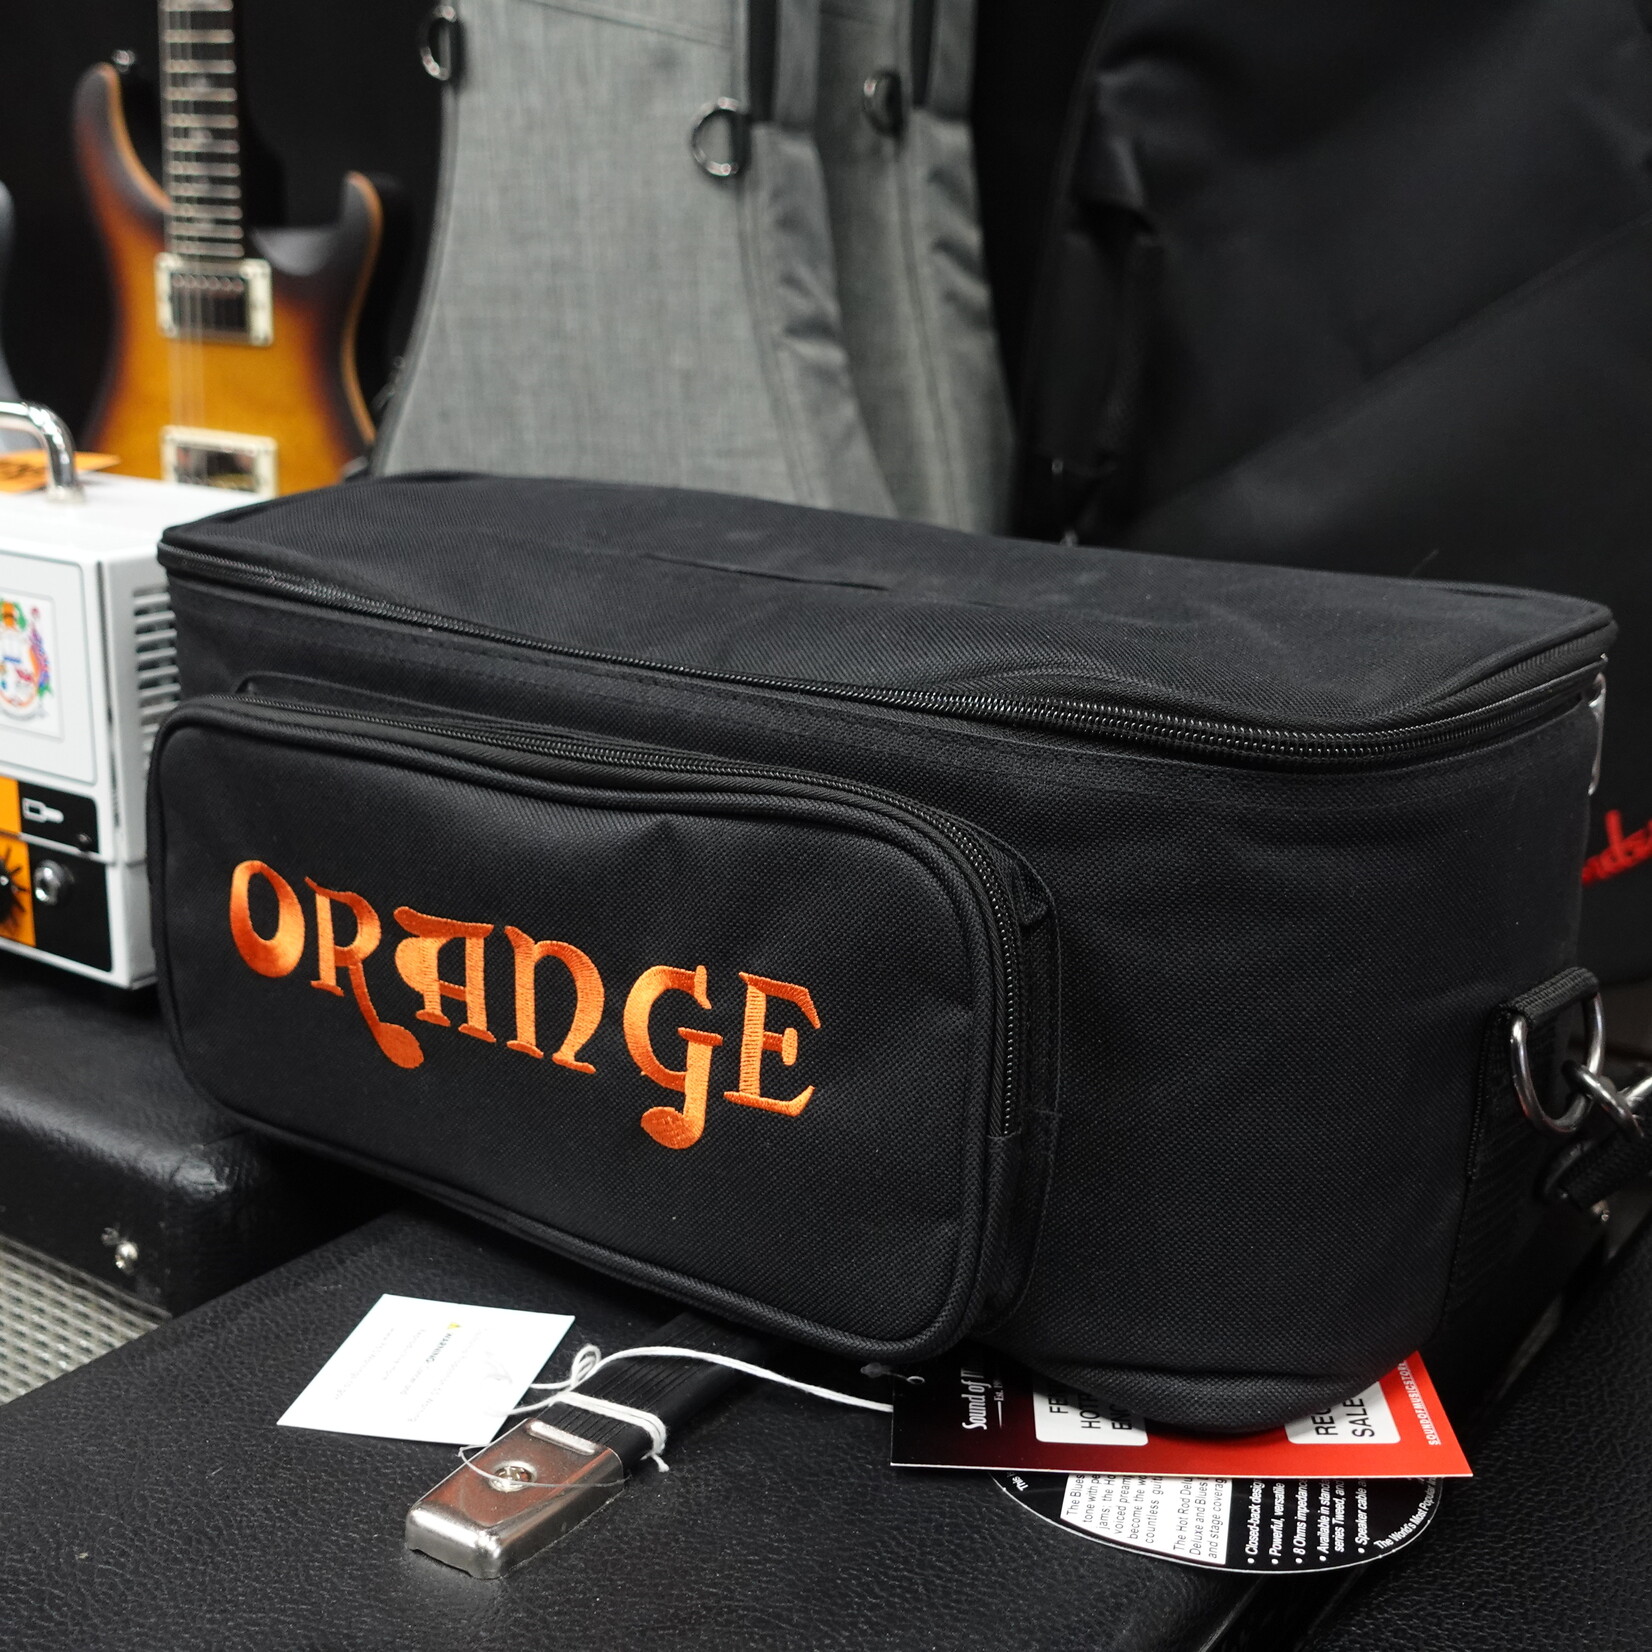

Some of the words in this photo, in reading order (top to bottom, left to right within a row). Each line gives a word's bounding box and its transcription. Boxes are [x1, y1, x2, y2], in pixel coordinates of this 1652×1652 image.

[229, 859, 821, 1149] ORANGE
[961, 1379, 992, 1393] of
[961, 1394, 987, 1430] Sound
[1070, 1475, 1085, 1497] Blues
[1086, 1486, 1099, 1502] with
[1102, 1488, 1113, 1502] the
[1133, 1489, 1145, 1502] the
[1194, 1482, 1208, 1505] Blues
[1066, 1499, 1080, 1515] The
[1177, 1497, 1191, 1514] Rod
[1270, 1482, 1285, 1515] versatile
[1333, 1497, 1346, 1524] Tweed,
[1355, 1488, 1367, 1509] cable
[1082, 1504, 1096, 1523] tone
[1114, 1506, 1127, 1534] voiced
[1128, 1506, 1142, 1539] become
[1144, 1499, 1160, 1544] countless
[1175, 1516, 1188, 1532] Hot
[1192, 1507, 1205, 1523] and
[1209, 1514, 1223, 1539] stage
[1244, 1503, 1262, 1555] Closed-back
[1269, 1518, 1285, 1556] Powerful,
[1295, 1522, 1307, 1547] Ohms
[1317, 1516, 1331, 1554] Available
[1355, 1511, 1370, 1545] Speaker
[1173, 1534, 1187, 1551] The
[1189, 1525, 1203, 1555] Deluxe
[1207, 1541, 1219, 1559] and
[1332, 1527, 1345, 1552] series
[1373, 1539, 1394, 1550] The
